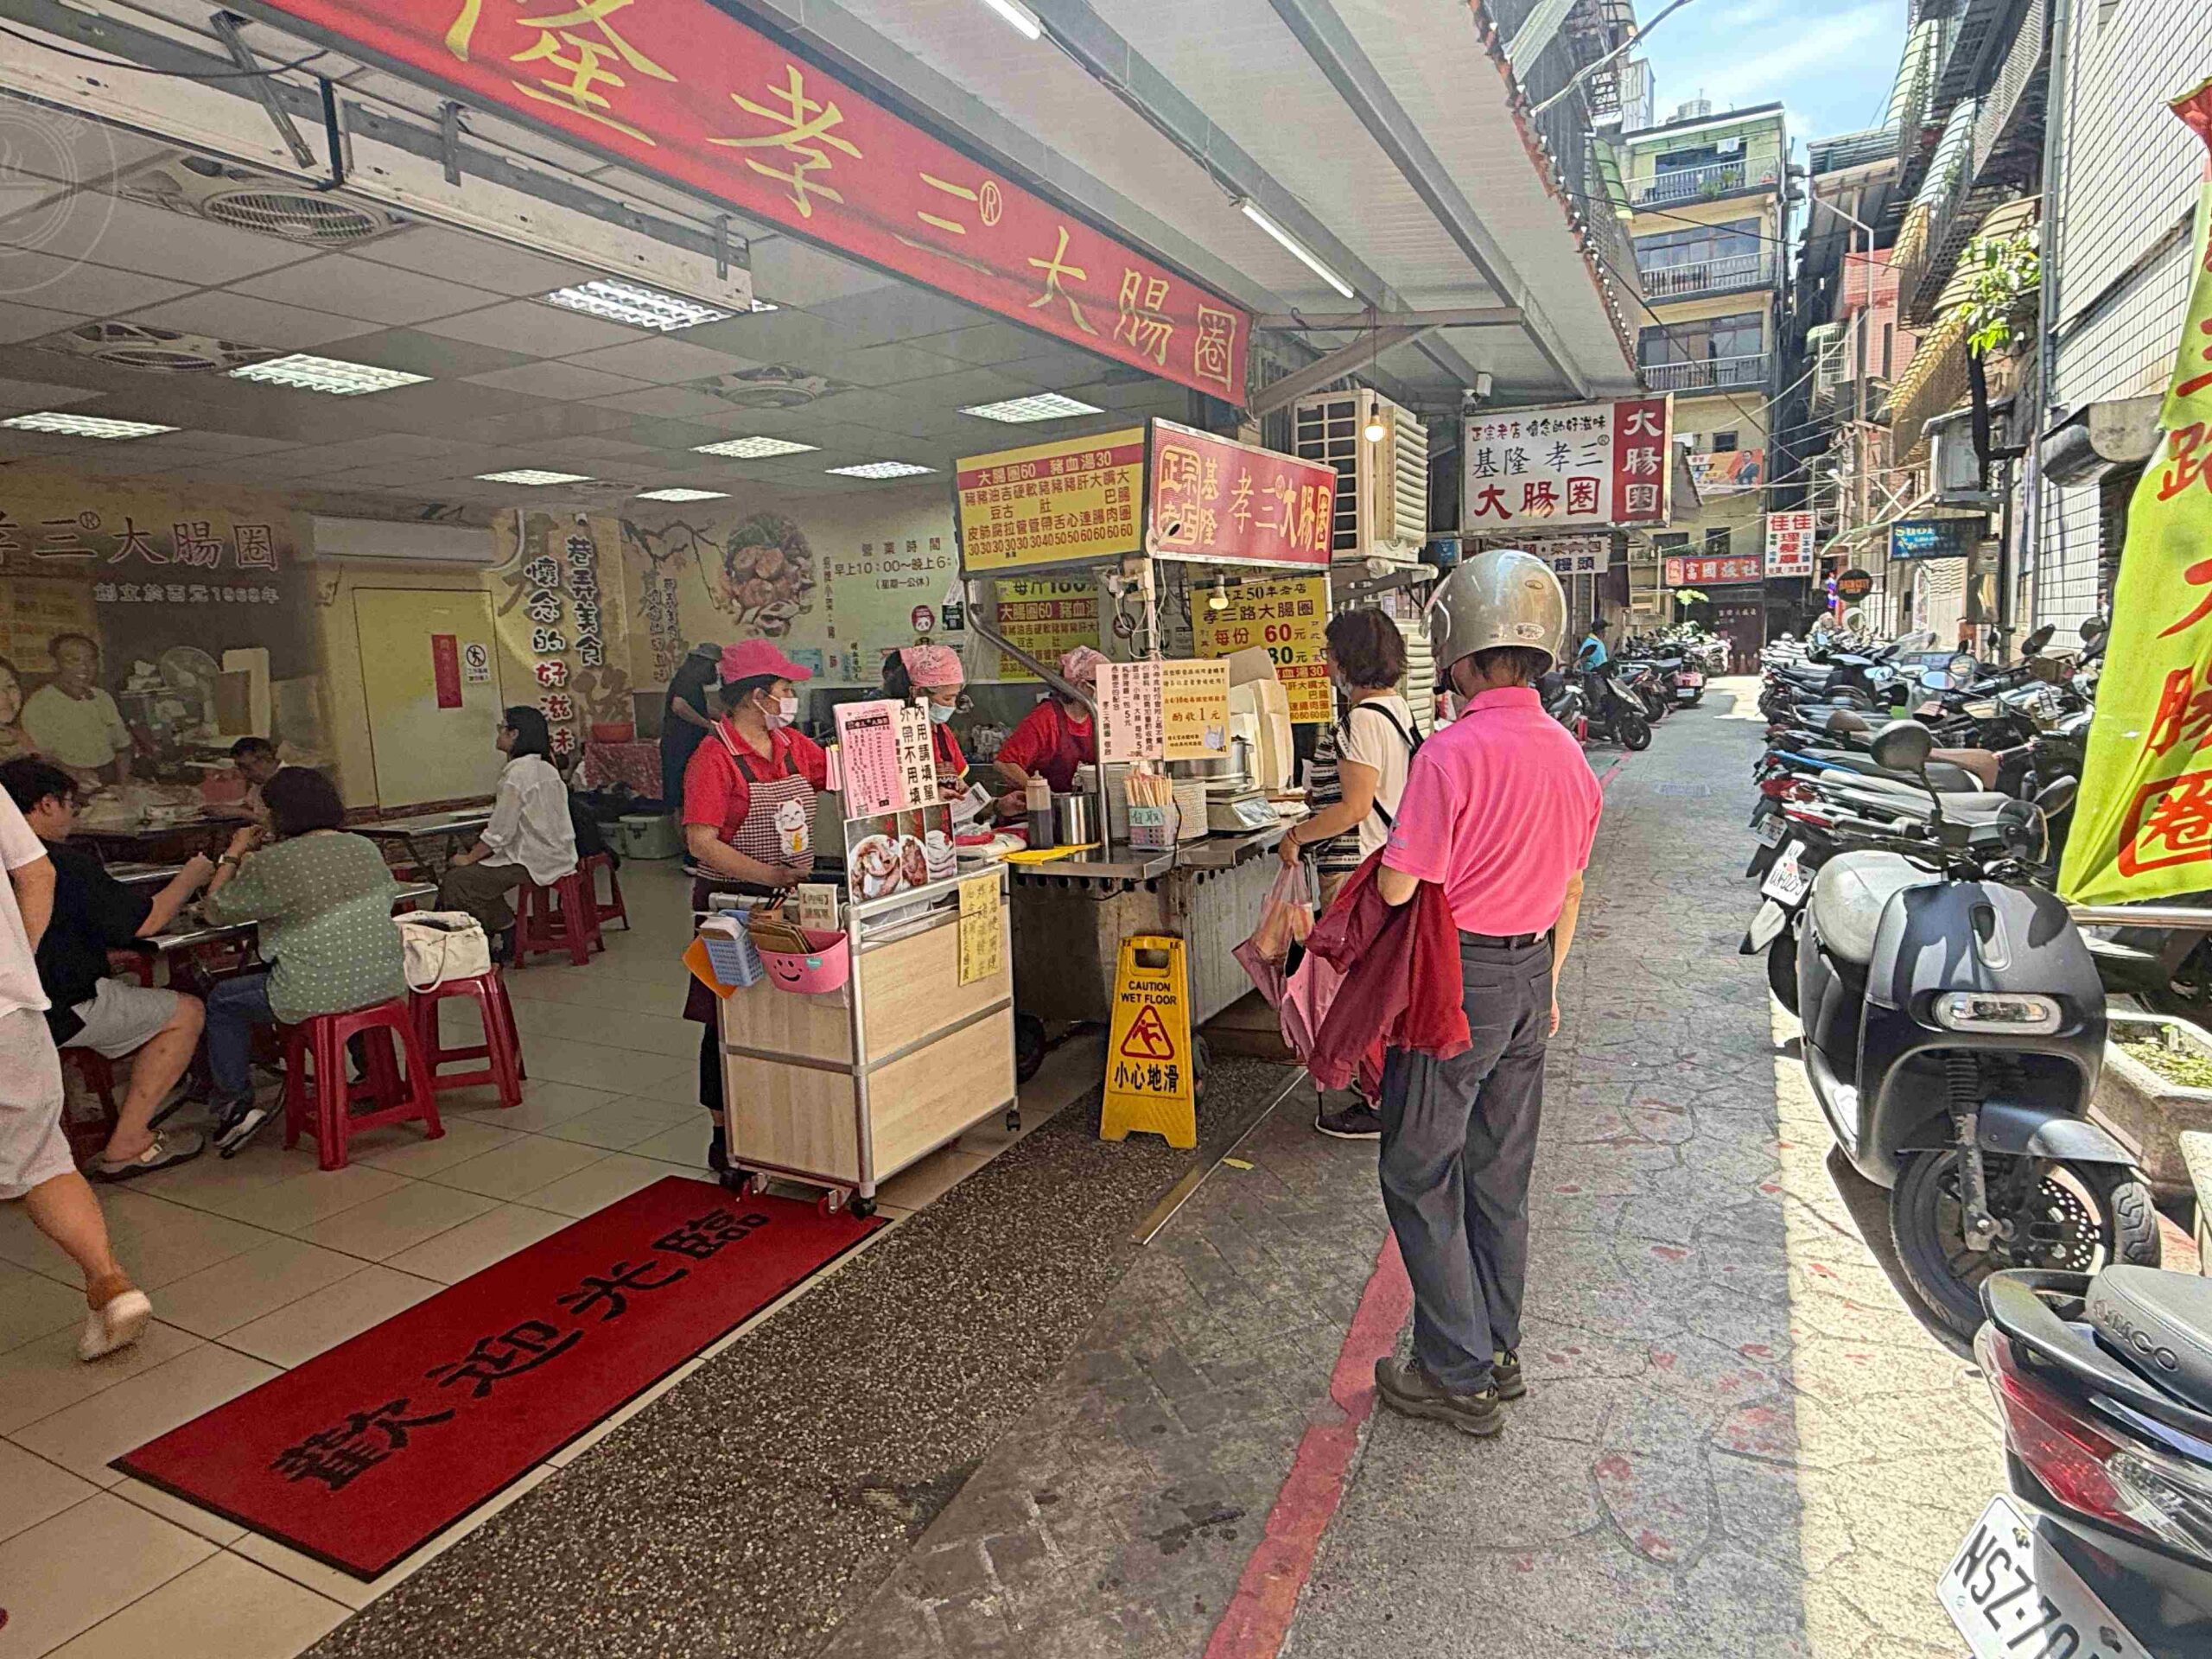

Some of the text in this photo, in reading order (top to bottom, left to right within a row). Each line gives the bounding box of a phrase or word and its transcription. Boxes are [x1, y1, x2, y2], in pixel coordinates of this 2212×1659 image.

[1471, 446, 1532, 480] 基隆
[1621, 408, 1663, 514] 大腸圈
[1473, 476, 1601, 520] 大腸圈
[1770, 514, 1812, 531] 佳佳
[1054, 531, 1067, 544] 50
[1067, 530, 1080, 543] 50
[1080, 528, 1093, 542] 60
[1093, 526, 1106, 540] 60
[1107, 524, 1120, 538] 60
[1120, 524, 1134, 537] 60
[862, 537, 941, 556] 營業時間
[993, 539, 1004, 553] 30
[1005, 537, 1017, 551] 30
[1016, 536, 1028, 550] 30
[1030, 535, 1041, 548] 30
[1042, 533, 1054, 547] 40
[969, 543, 980, 556] 30
[980, 541, 992, 555] 30
[1203, 600, 1314, 625] 孝三路大腸圈
[1215, 627, 1249, 646] 每份
[1128, 980, 1171, 992] CAUTION
[1121, 991, 1176, 1006] WET FLOOR
[1114, 1060, 1179, 1094] 小心地滑
[269, 1208, 772, 1491] 歡迎光臨
